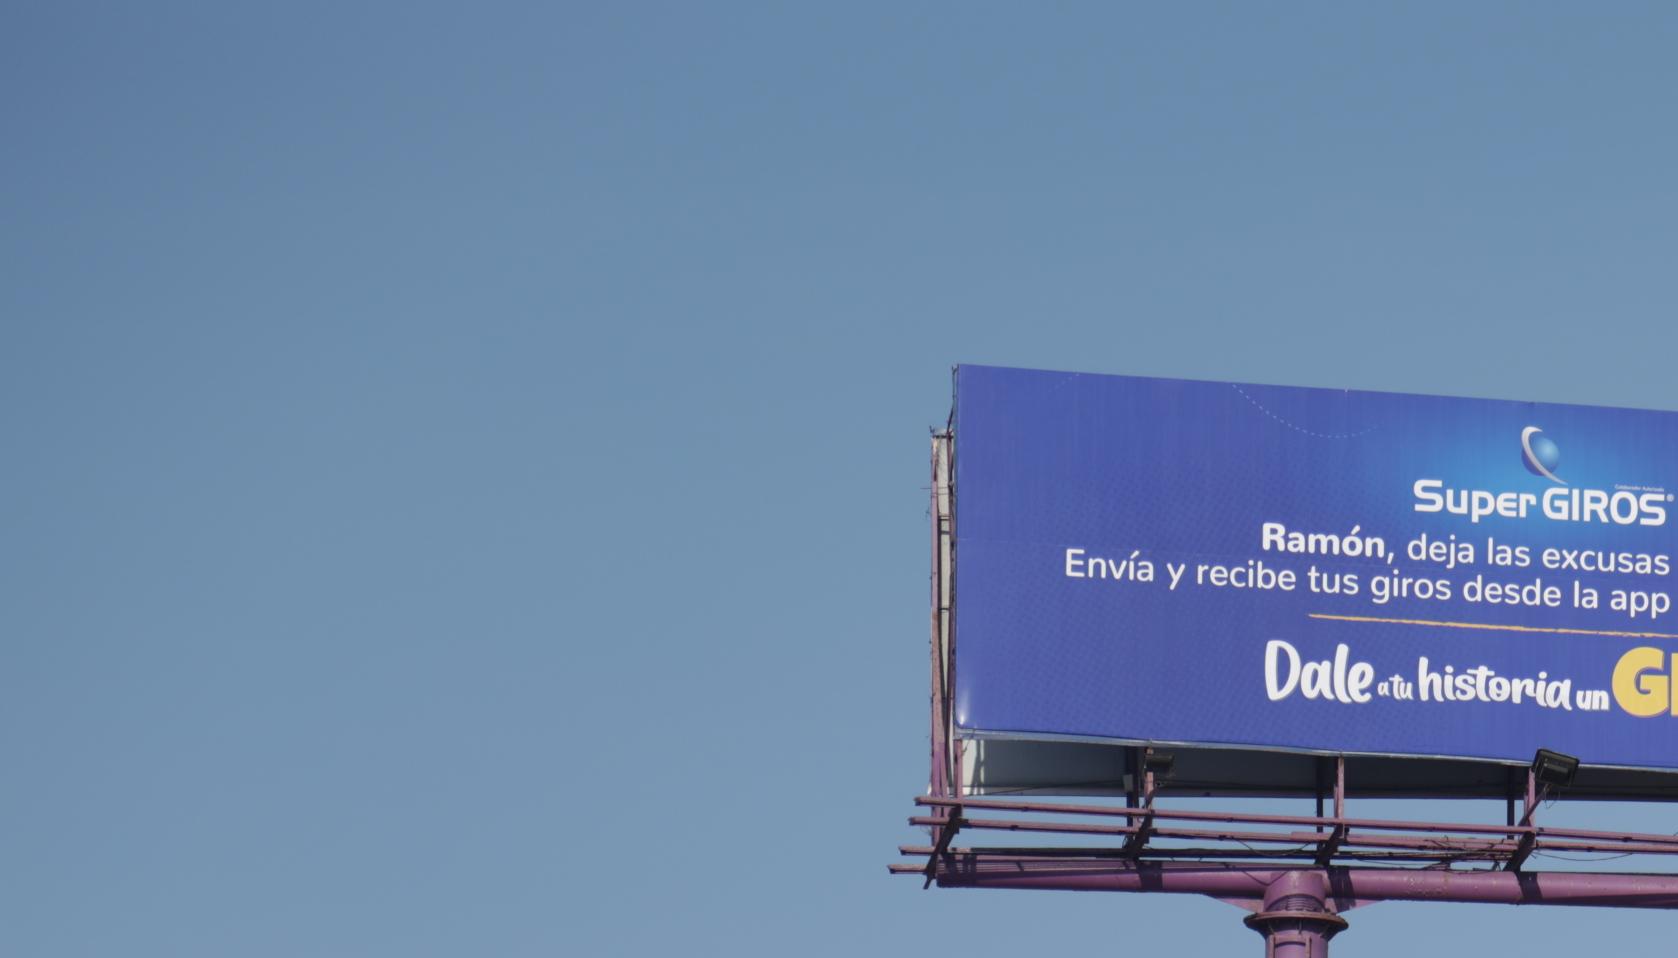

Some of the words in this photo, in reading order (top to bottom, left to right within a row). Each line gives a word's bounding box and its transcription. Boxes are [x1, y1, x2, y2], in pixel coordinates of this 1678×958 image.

[1065, 548, 1154, 582] Envía
[1166, 562, 1186, 591] y
[1197, 559, 1297, 591] recibe
[1307, 565, 1359, 595] tus
[1370, 568, 1452, 605] giros
[1462, 574, 1562, 608] desde
[1573, 580, 1599, 609] la
[1610, 589, 1671, 620] app
[1262, 522, 1395, 565] Ramón,
[1407, 532, 1475, 570] deja
[1487, 536, 1531, 568] las
[1542, 547, 1670, 576] excusas
[1264, 639, 1375, 704] Dale
[1417, 655, 1573, 711] historia
[1575, 689, 1610, 711] un
